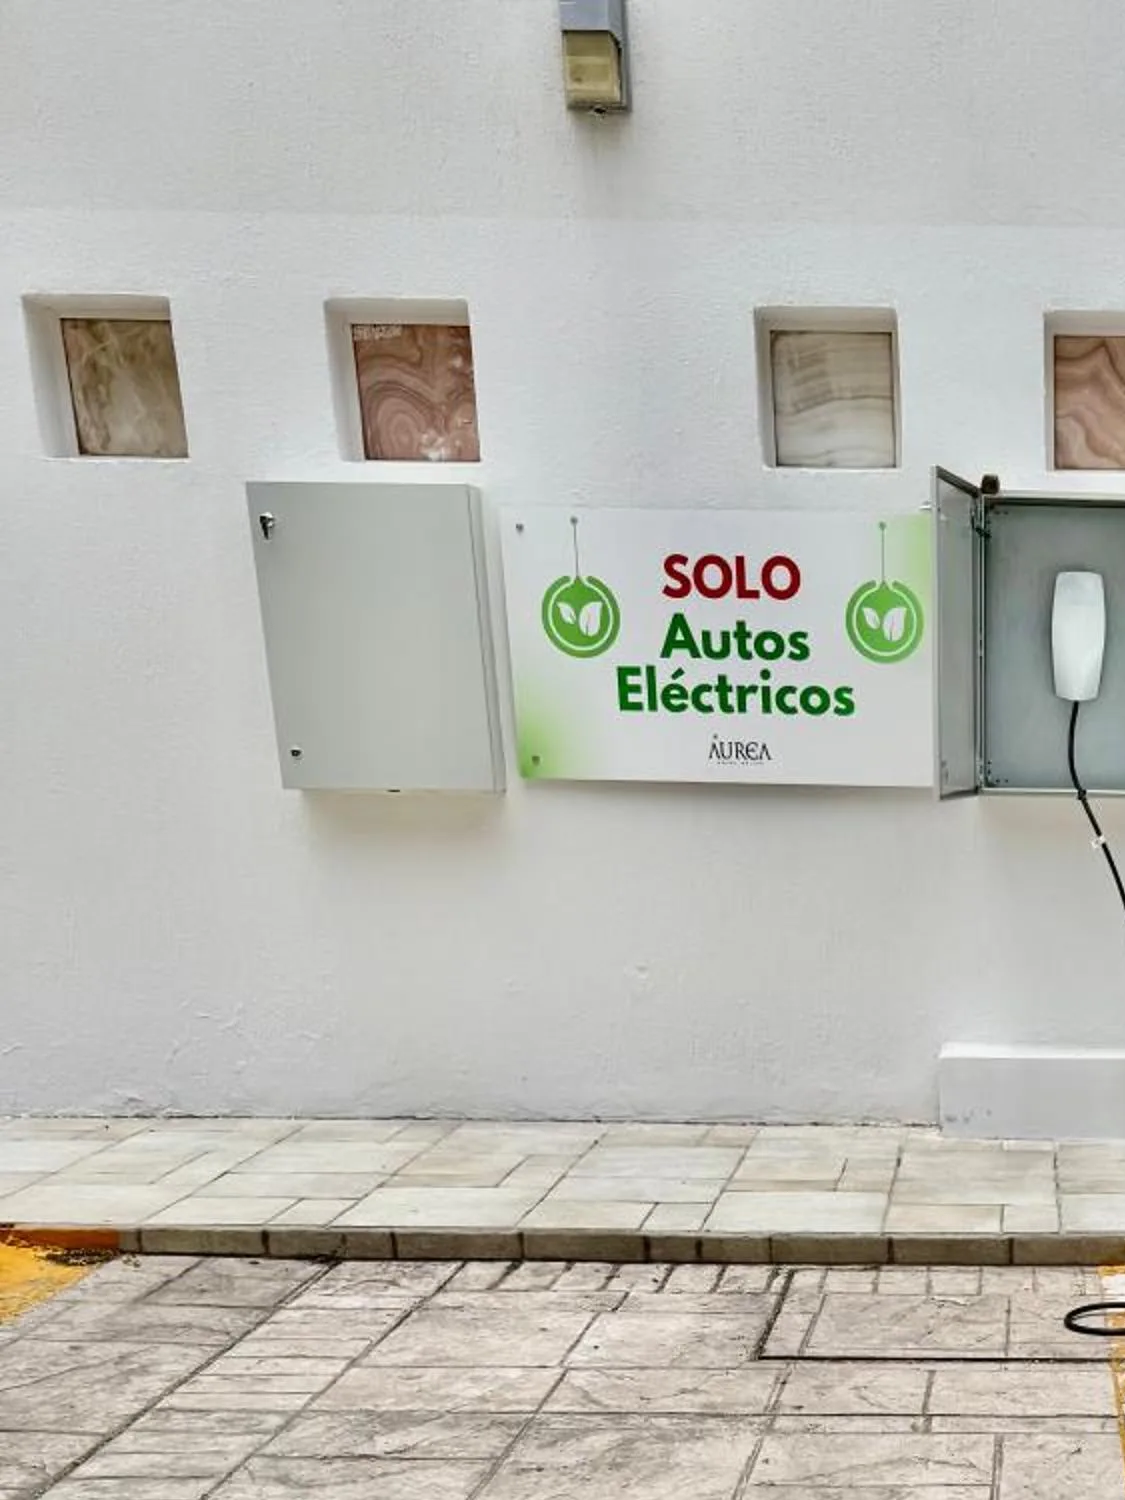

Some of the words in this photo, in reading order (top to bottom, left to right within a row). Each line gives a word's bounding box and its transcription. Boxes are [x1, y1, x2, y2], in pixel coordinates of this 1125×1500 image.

[663, 554, 801, 600] SOLO
[660, 612, 810, 661] Autos
[616, 665, 855, 716] Eléctricos
